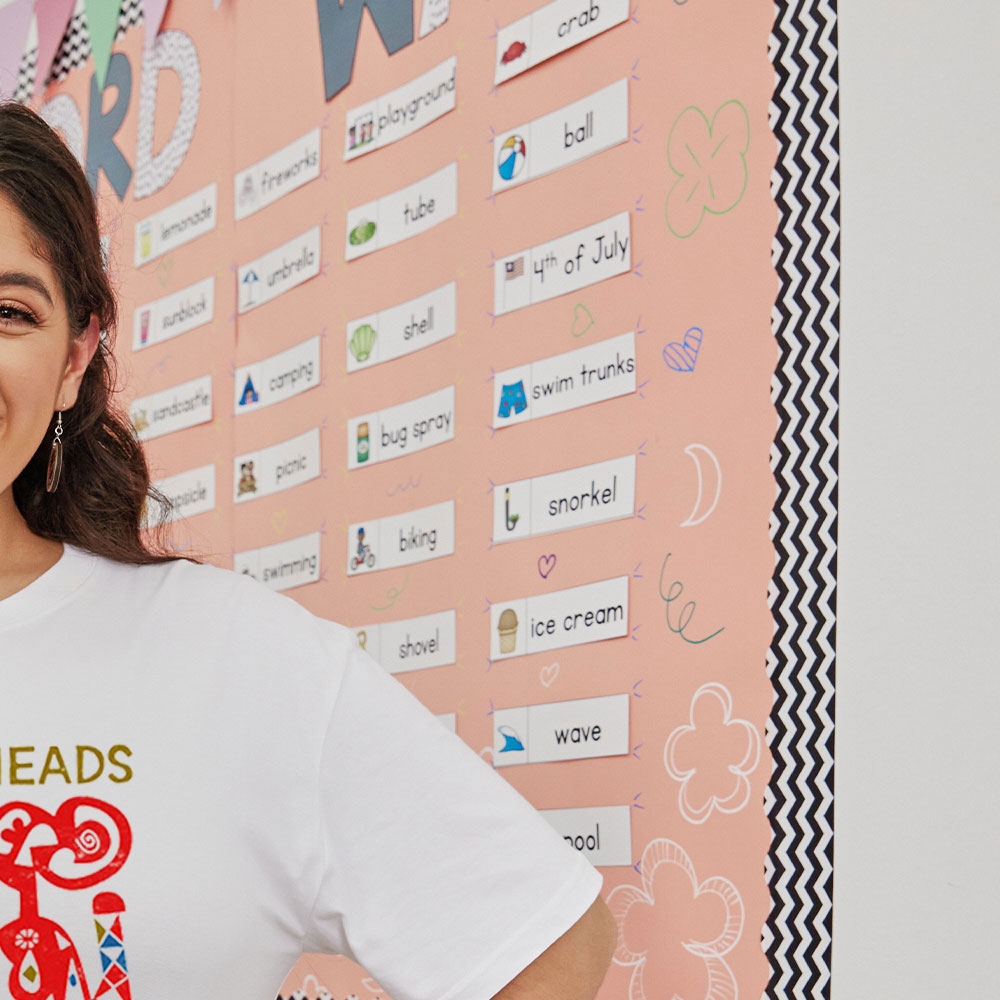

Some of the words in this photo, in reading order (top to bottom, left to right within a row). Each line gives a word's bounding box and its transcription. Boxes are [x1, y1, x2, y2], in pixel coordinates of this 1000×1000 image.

[557, 0, 600, 38] crab
[377, 66, 456, 136] playground
[563, 110, 594, 149] ball
[261, 148, 318, 194] fireworks
[160, 200, 212, 241] lemonade
[403, 195, 436, 225] tube
[267, 246, 315, 288] umbrella
[533, 251, 558, 284] 4th
[563, 244, 585, 276] of
[592, 230, 629, 264] July
[162, 293, 207, 330] sunblock
[403, 306, 434, 341] shell
[269, 361, 314, 392] camping
[531, 373, 575, 400] swim
[581, 352, 635, 386] trunks
[152, 387, 210, 422] sandcastle
[380, 425, 407, 448] bug
[412, 410, 452, 442] spray
[276, 455, 307, 484] picnic
[548, 475, 617, 516] snorkel
[398, 526, 438, 553] biking
[262, 553, 317, 583] swimming
[529, 617, 556, 639] ice
[563, 603, 624, 633] cream
[398, 627, 440, 659] shovel
[554, 724, 602, 745] wave
